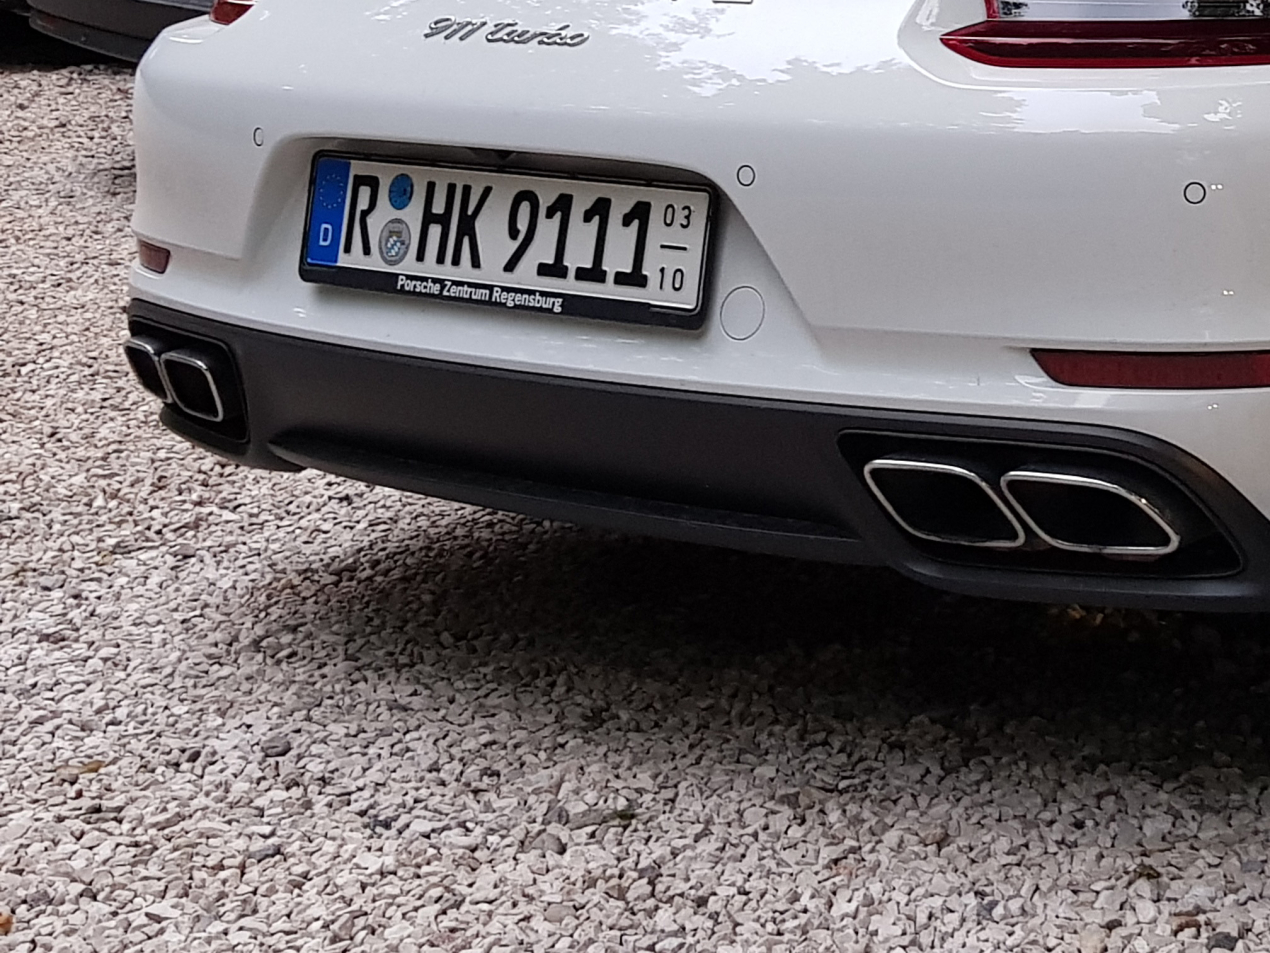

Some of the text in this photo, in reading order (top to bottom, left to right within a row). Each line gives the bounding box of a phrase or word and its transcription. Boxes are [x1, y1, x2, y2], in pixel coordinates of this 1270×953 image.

[423, 14, 591, 48] 911 turbo
[343, 174, 653, 288] R HK 9111
[663, 203, 695, 230] 03
[318, 222, 333, 247] D
[397, 275, 564, 313] Porsche Zentrum Regensburg
[658, 266, 685, 293] 10
